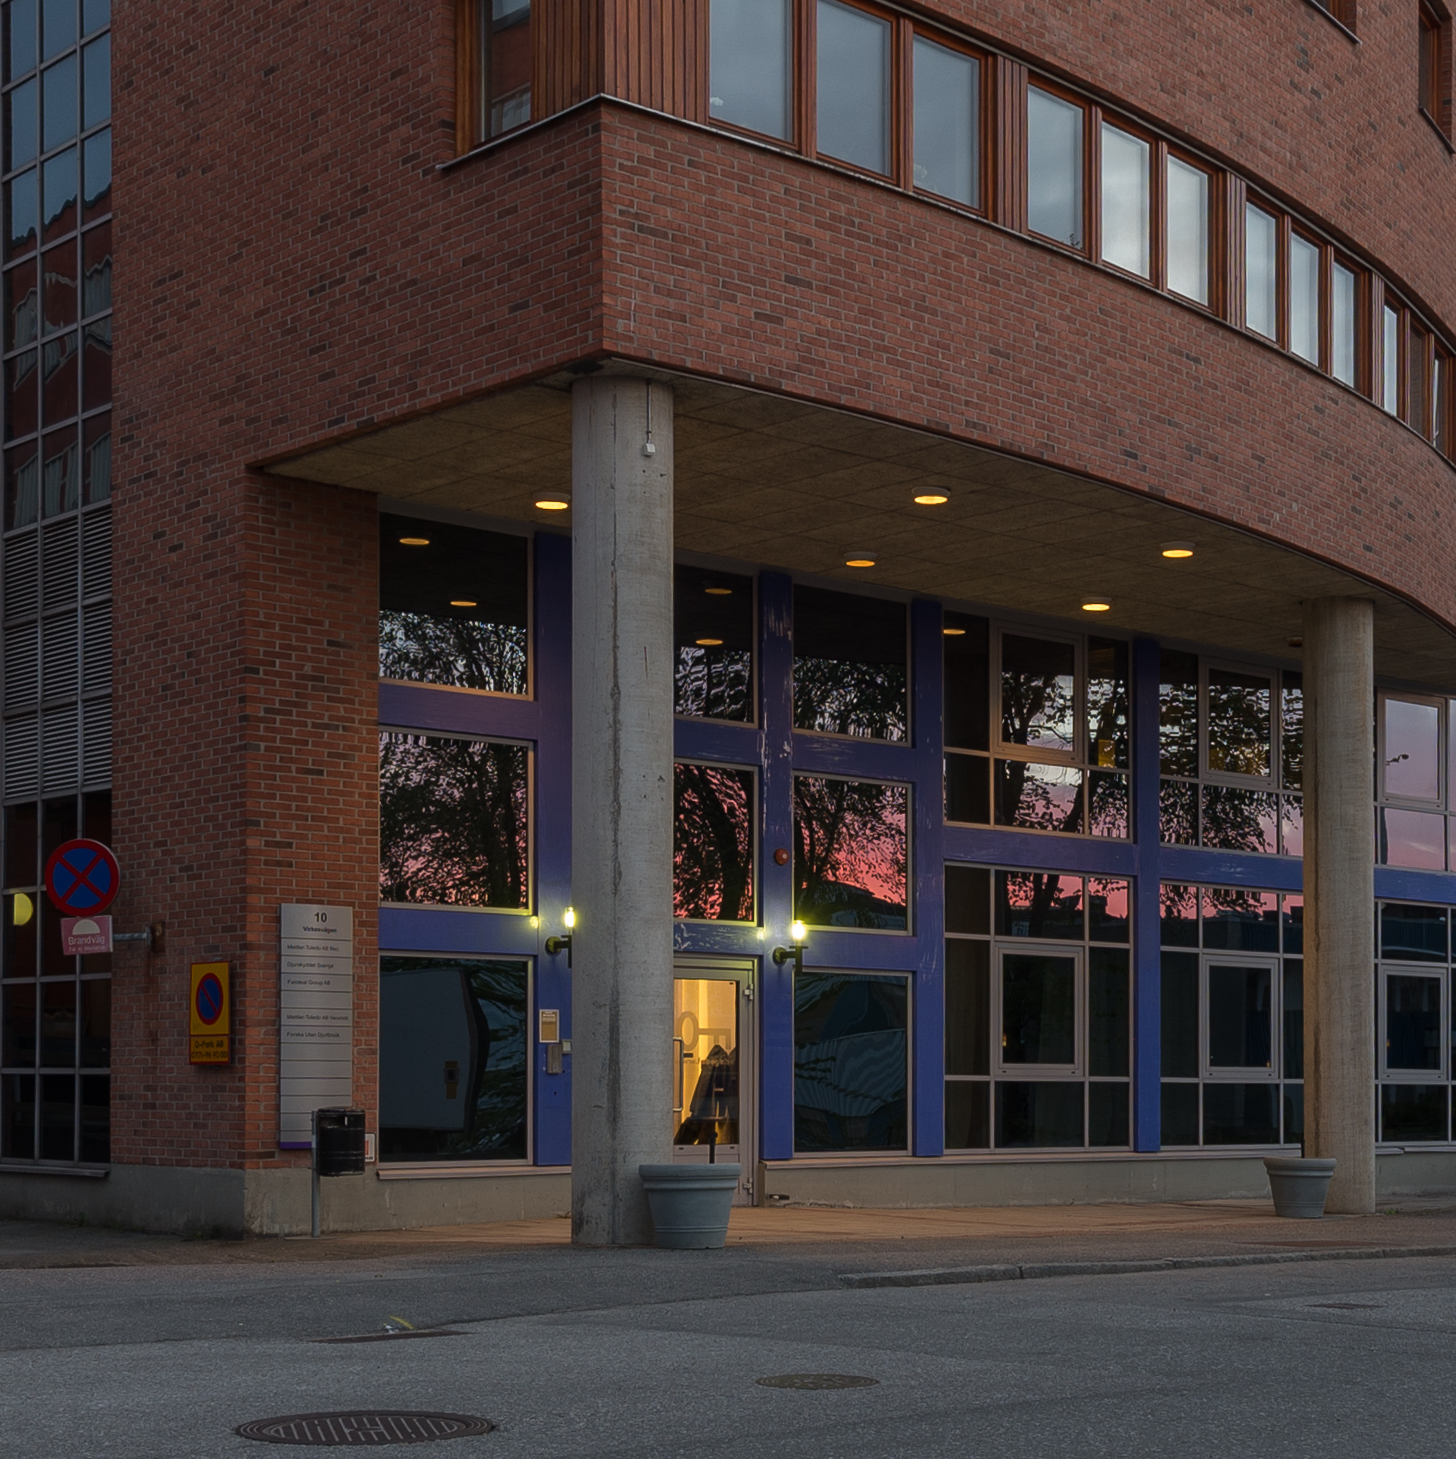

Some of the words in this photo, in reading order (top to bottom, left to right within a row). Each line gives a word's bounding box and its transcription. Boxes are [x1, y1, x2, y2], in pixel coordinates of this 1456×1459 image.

[314, 912, 327, 922] 10
[68, 935, 105, 946] Brandväg
[216, 1040, 224, 1048] AB
